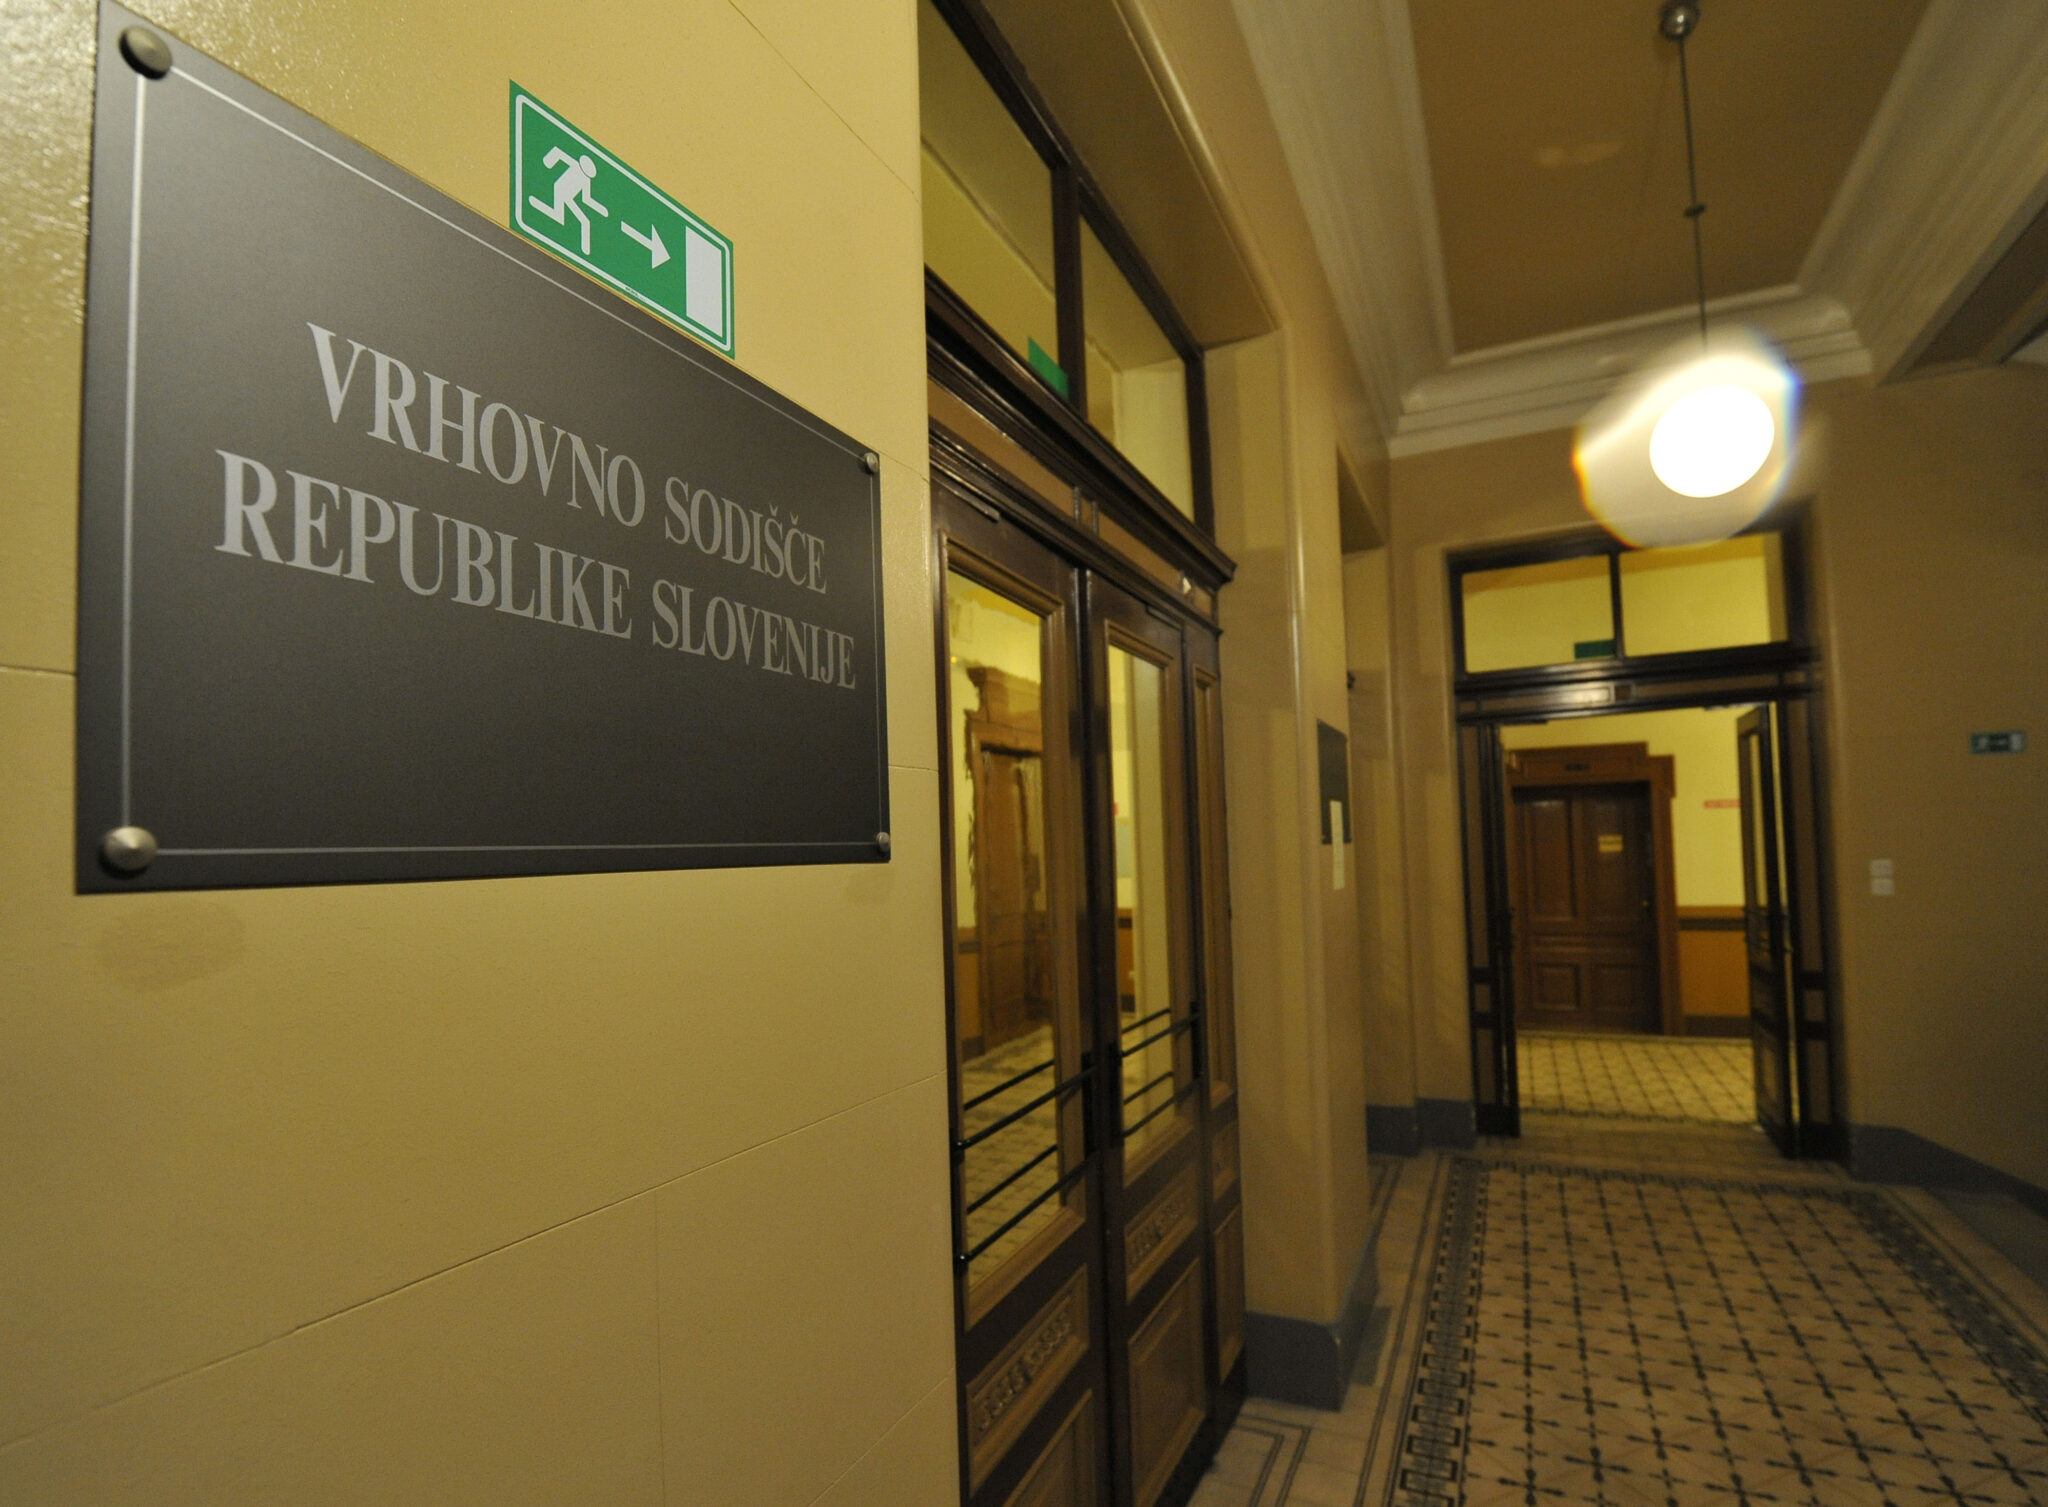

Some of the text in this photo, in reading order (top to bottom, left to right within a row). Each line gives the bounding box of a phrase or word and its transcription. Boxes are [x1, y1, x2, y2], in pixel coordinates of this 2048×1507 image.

[213, 448, 857, 690] REPUBLIKE SLOVENIJE
[306, 322, 828, 595] VRHOVNO SODIŠČE
